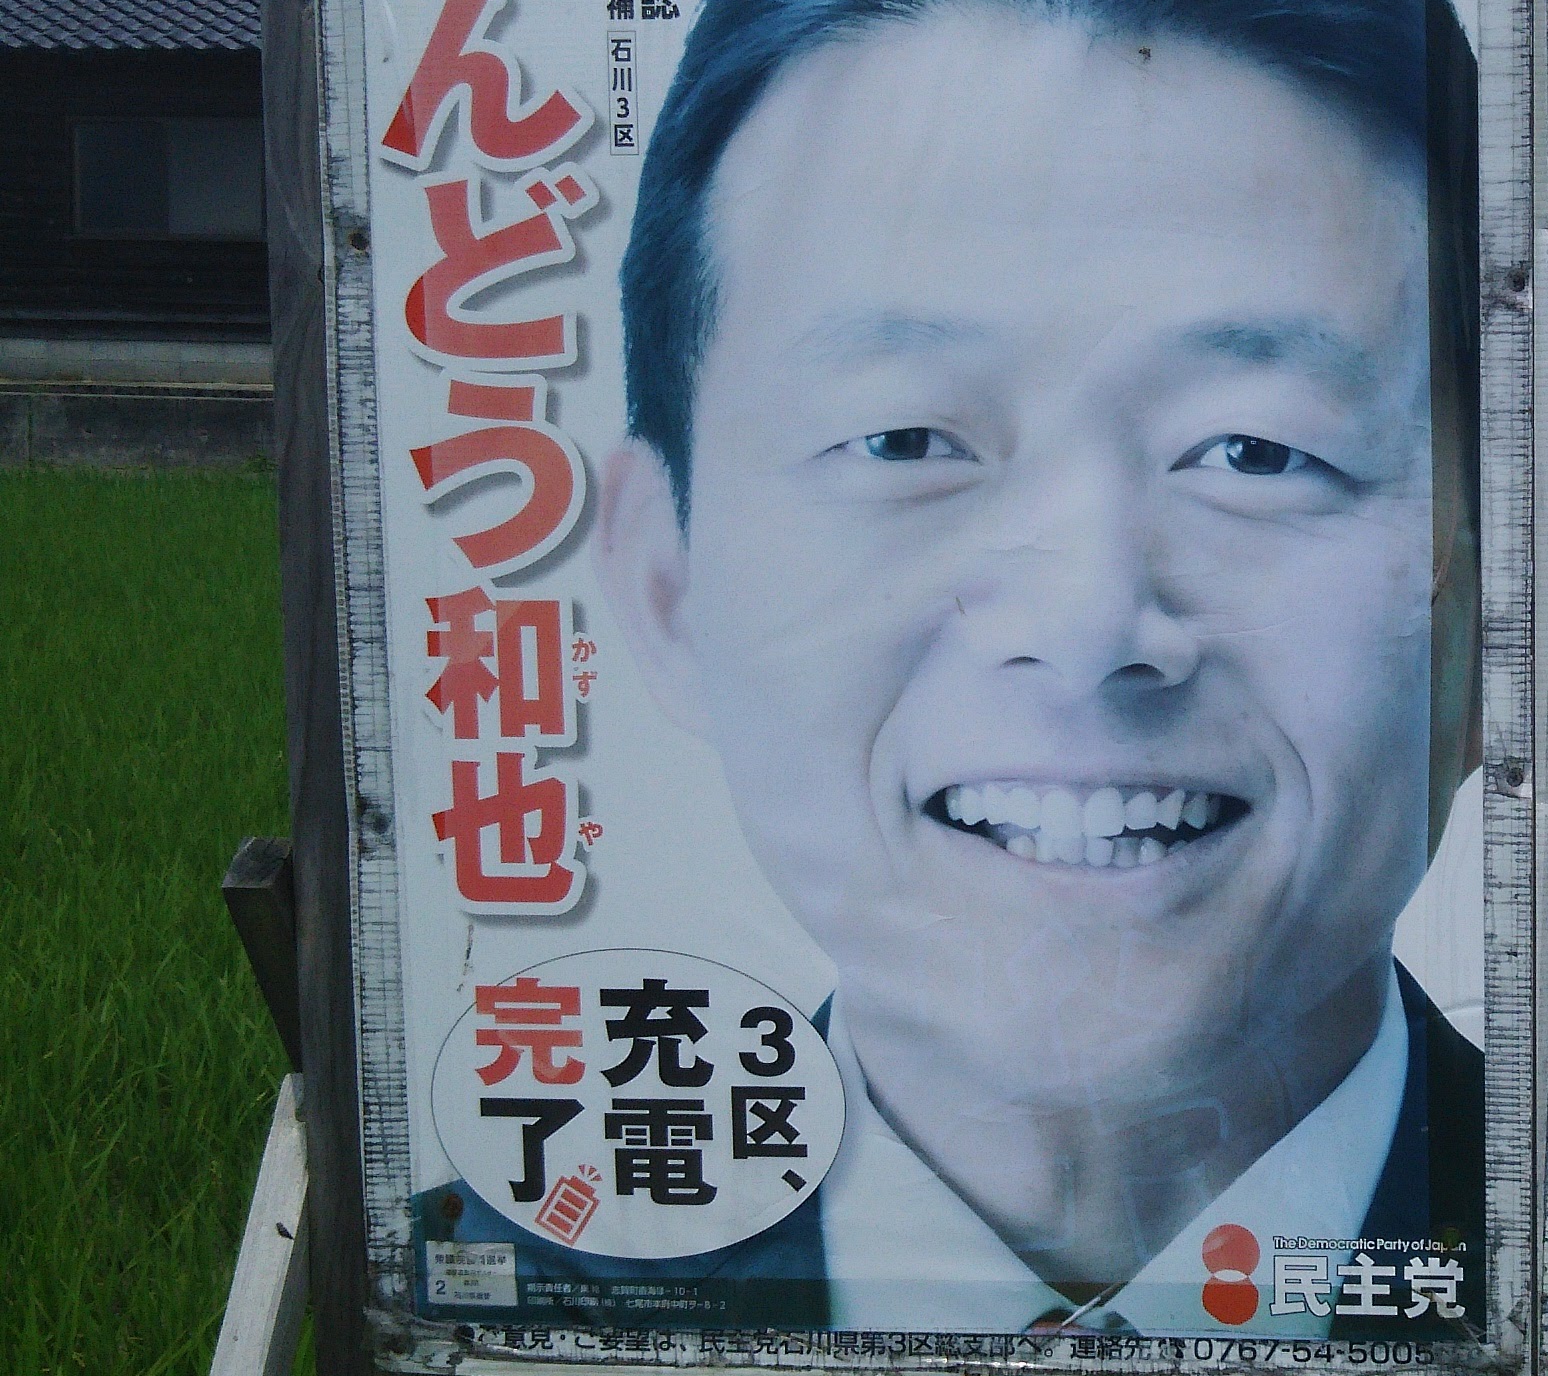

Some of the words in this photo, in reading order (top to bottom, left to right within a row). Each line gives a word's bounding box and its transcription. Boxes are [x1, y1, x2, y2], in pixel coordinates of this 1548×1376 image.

[474, 977, 586, 1203] 完了
[600, 978, 717, 1206] 充電
[1270, 1252, 1466, 1319] 民主党
[1274, 1237, 1299, 1249] The
[1299, 1237, 1375, 1251] Democratic
[1377, 1238, 1410, 1252] Party
[1411, 1239, 1424, 1251] of
[1425, 1240, 1466, 1255] Japn
